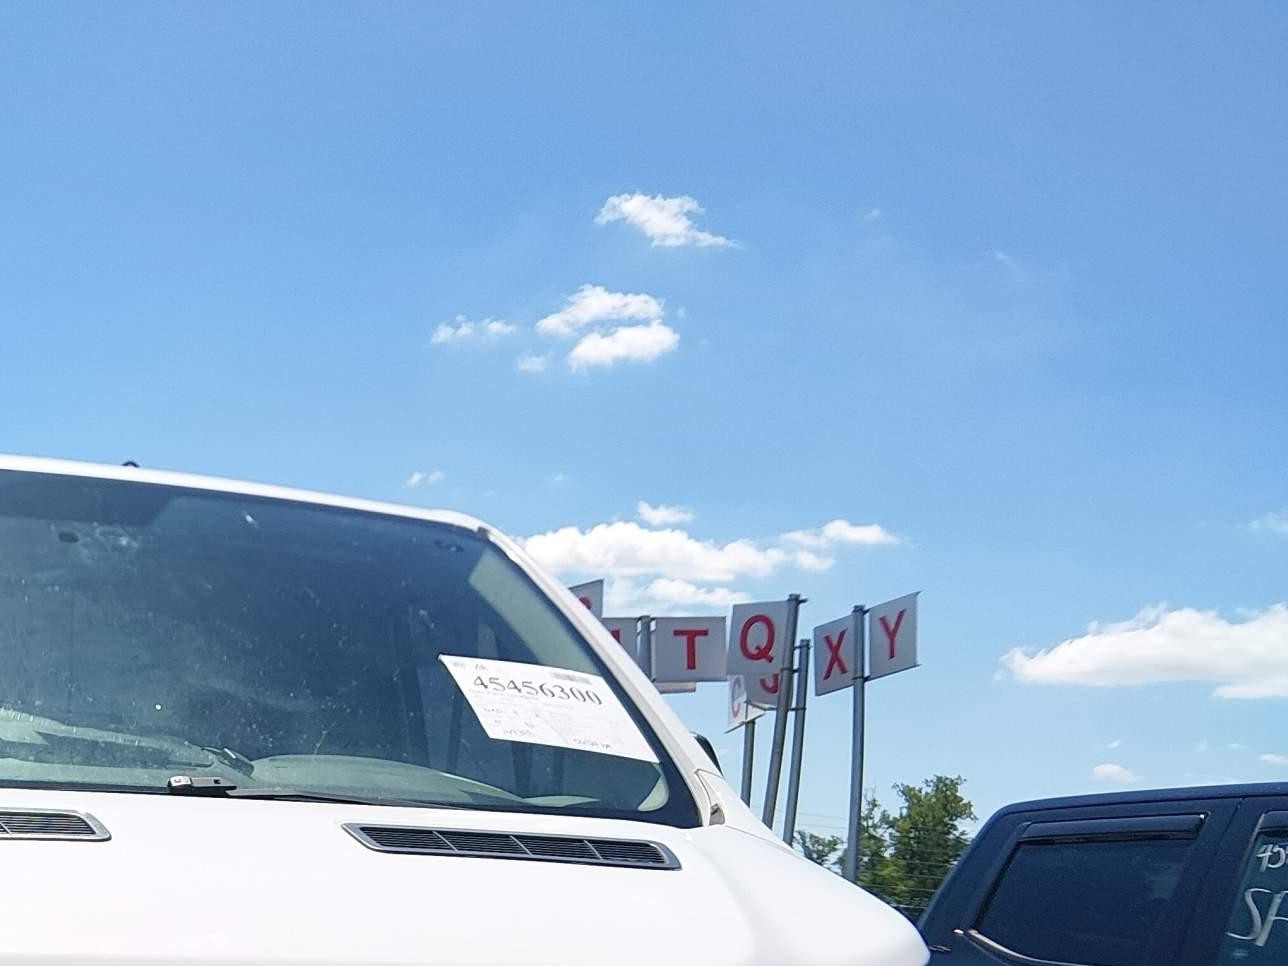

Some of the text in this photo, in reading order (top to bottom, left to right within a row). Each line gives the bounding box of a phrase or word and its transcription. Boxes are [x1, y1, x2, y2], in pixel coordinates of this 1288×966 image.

[673, 629, 709, 671] T
[740, 614, 775, 663] Q
[823, 628, 848, 680] X
[879, 608, 906, 660] Y
[473, 675, 603, 706] 45456300
